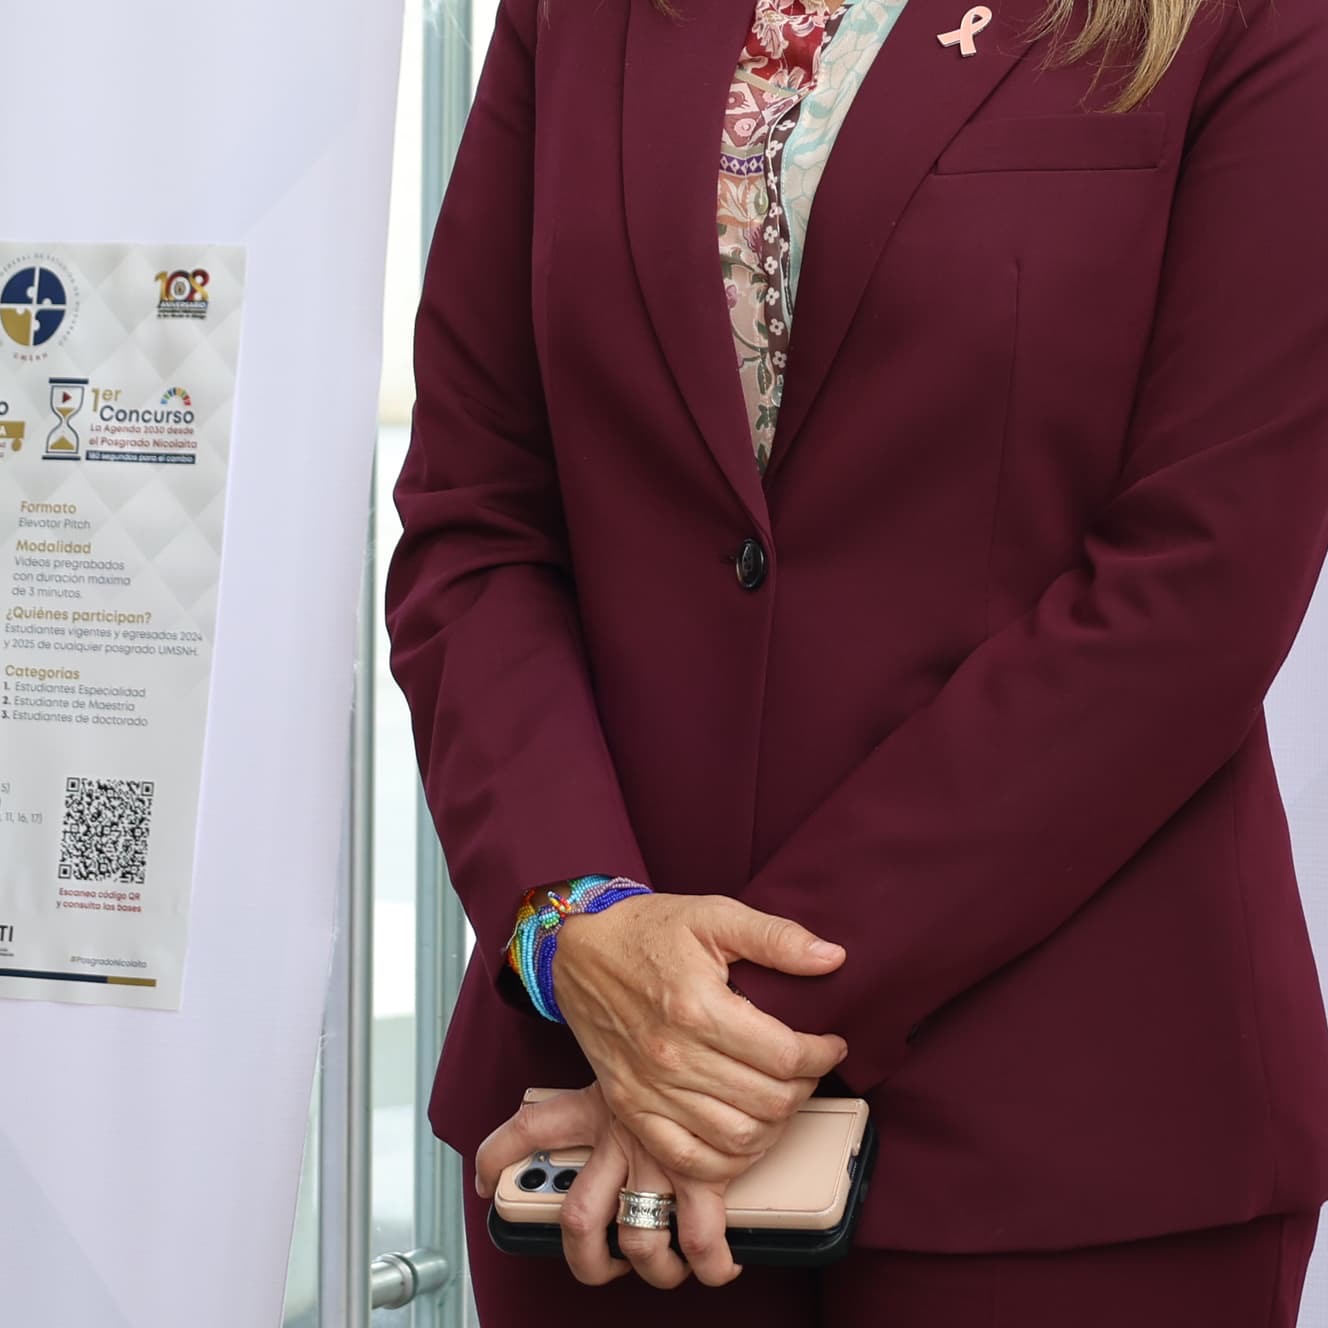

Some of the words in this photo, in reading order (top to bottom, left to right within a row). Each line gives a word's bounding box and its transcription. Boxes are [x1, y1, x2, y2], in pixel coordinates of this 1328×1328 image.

[100, 405, 195, 425] Concurso
[20, 500, 77, 515] Formato
[16, 539, 91, 554] Modalidad
[6, 607, 68, 623] ¿Quiénes
[71, 609, 151, 625] participan?
